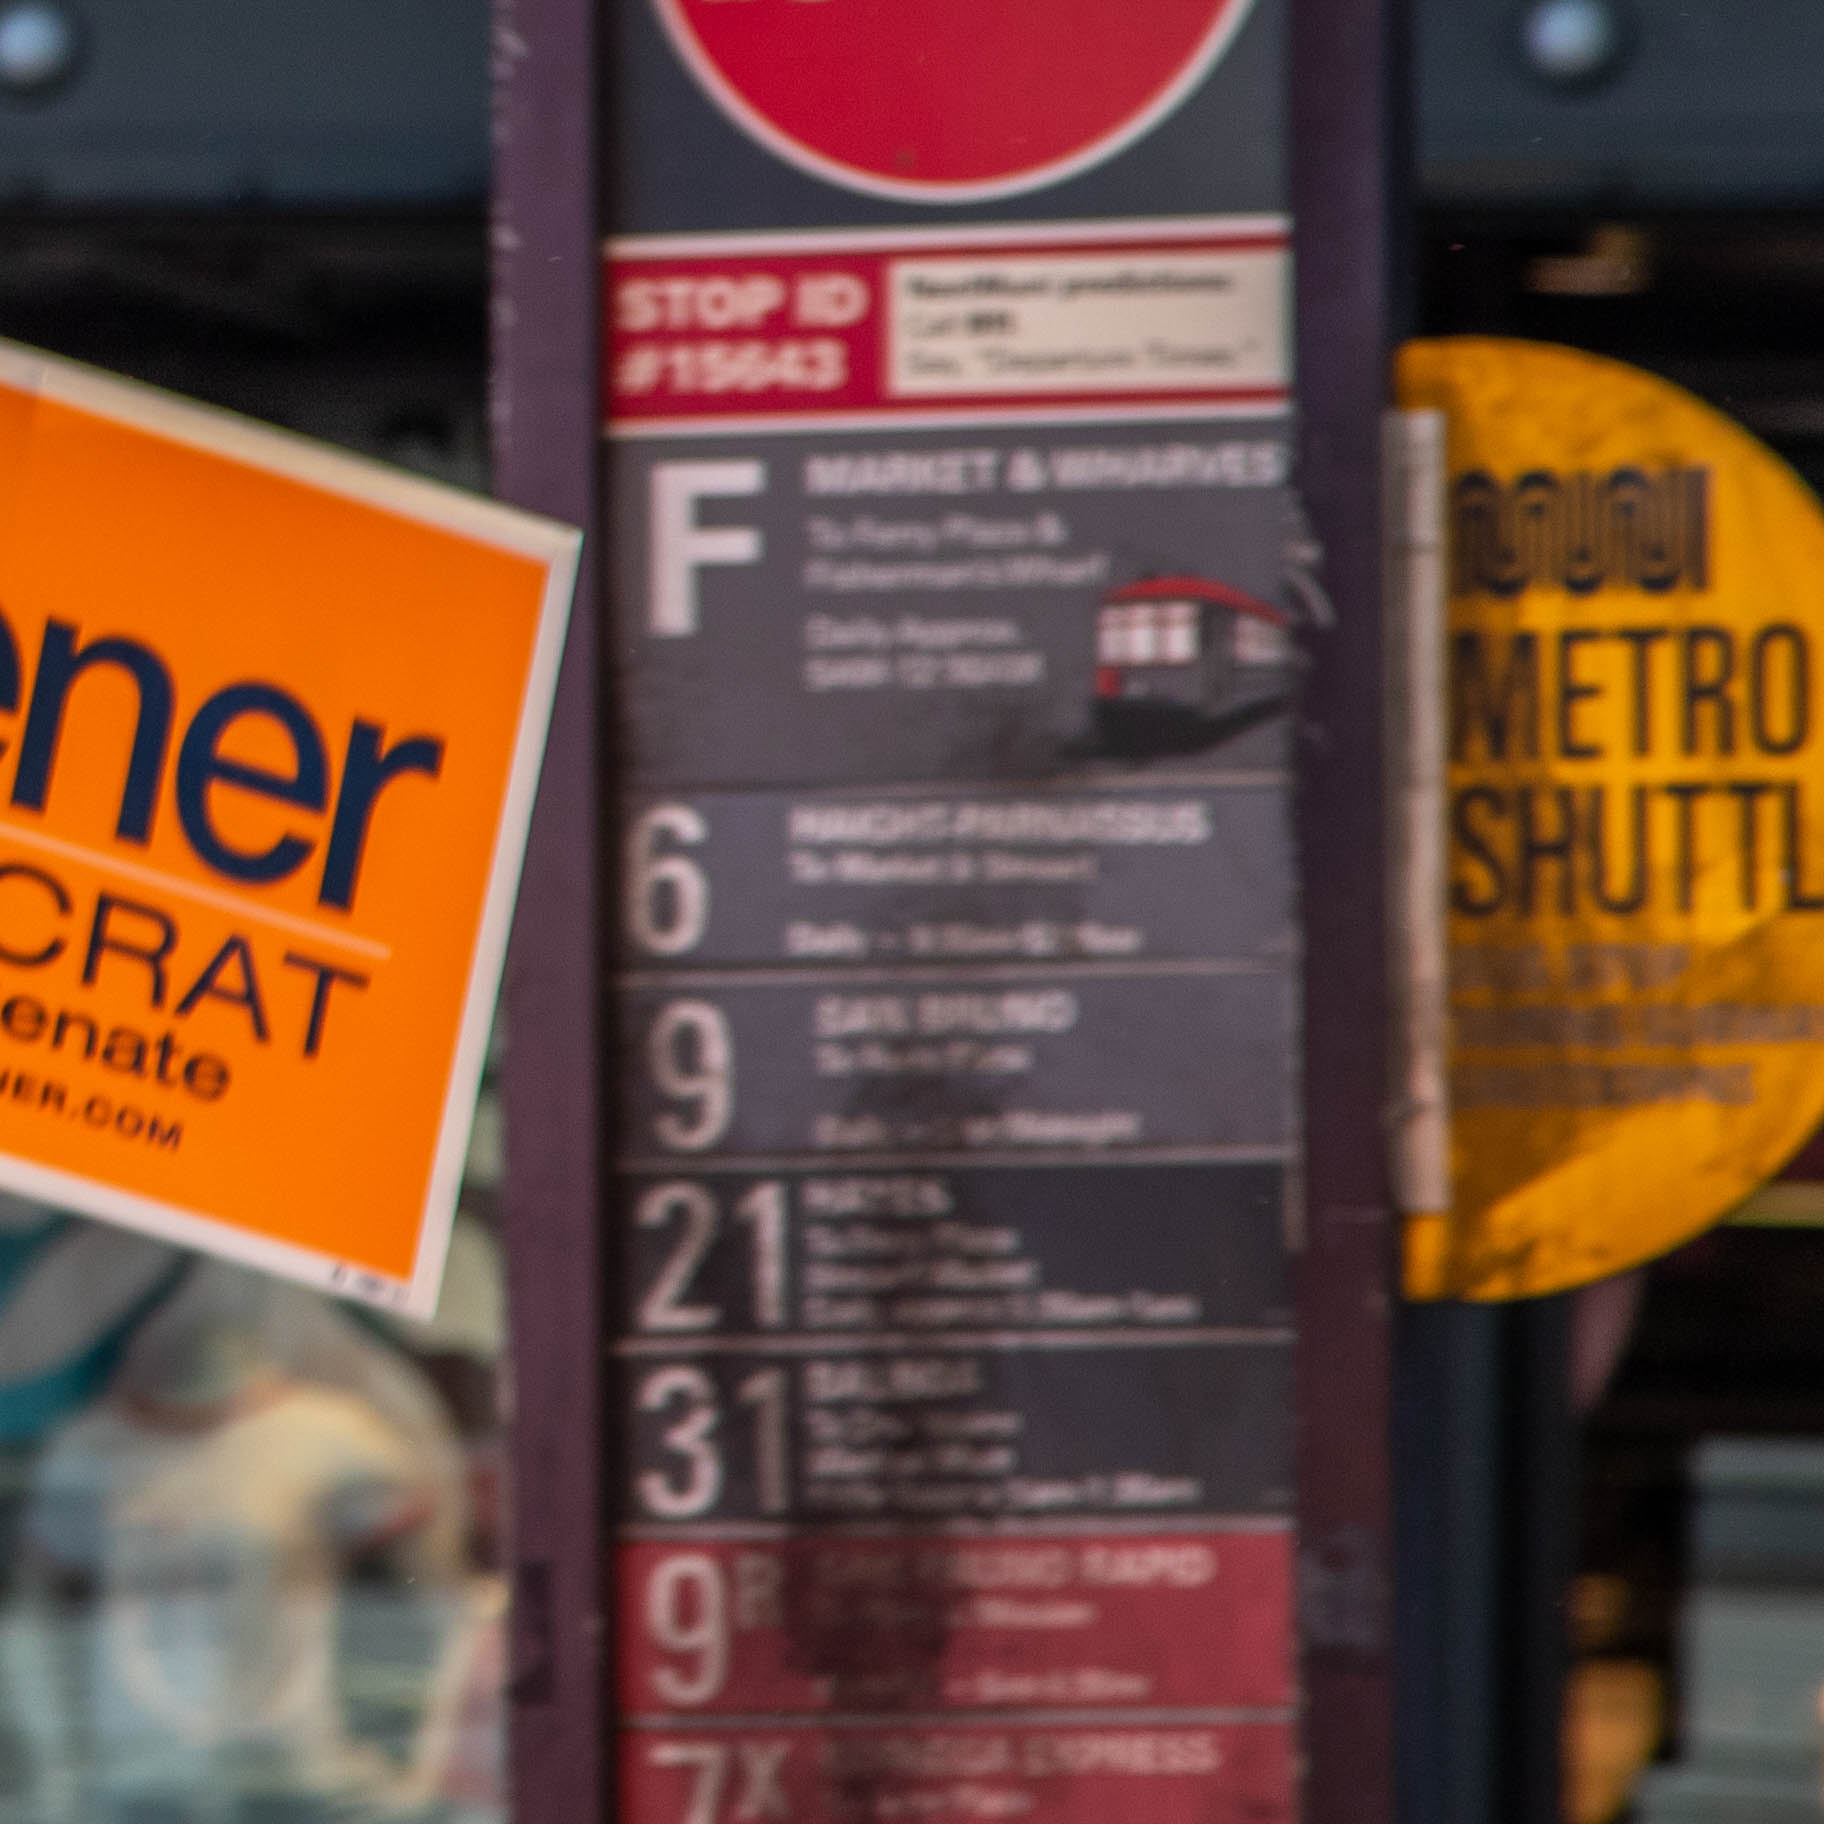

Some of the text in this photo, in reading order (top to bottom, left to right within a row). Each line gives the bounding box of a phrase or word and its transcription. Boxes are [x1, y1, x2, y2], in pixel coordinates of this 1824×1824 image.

[616, 273, 870, 331] STOP ID
[805, 447, 998, 494] MARKET
[1007, 447, 1047, 492] &
[649, 457, 766, 639] F
[1451, 622, 1811, 764] METRO
[627, 802, 711, 956] 6
[650, 998, 734, 1152] 9
[637, 1181, 790, 1330] 21
[637, 1363, 790, 1519] 31
